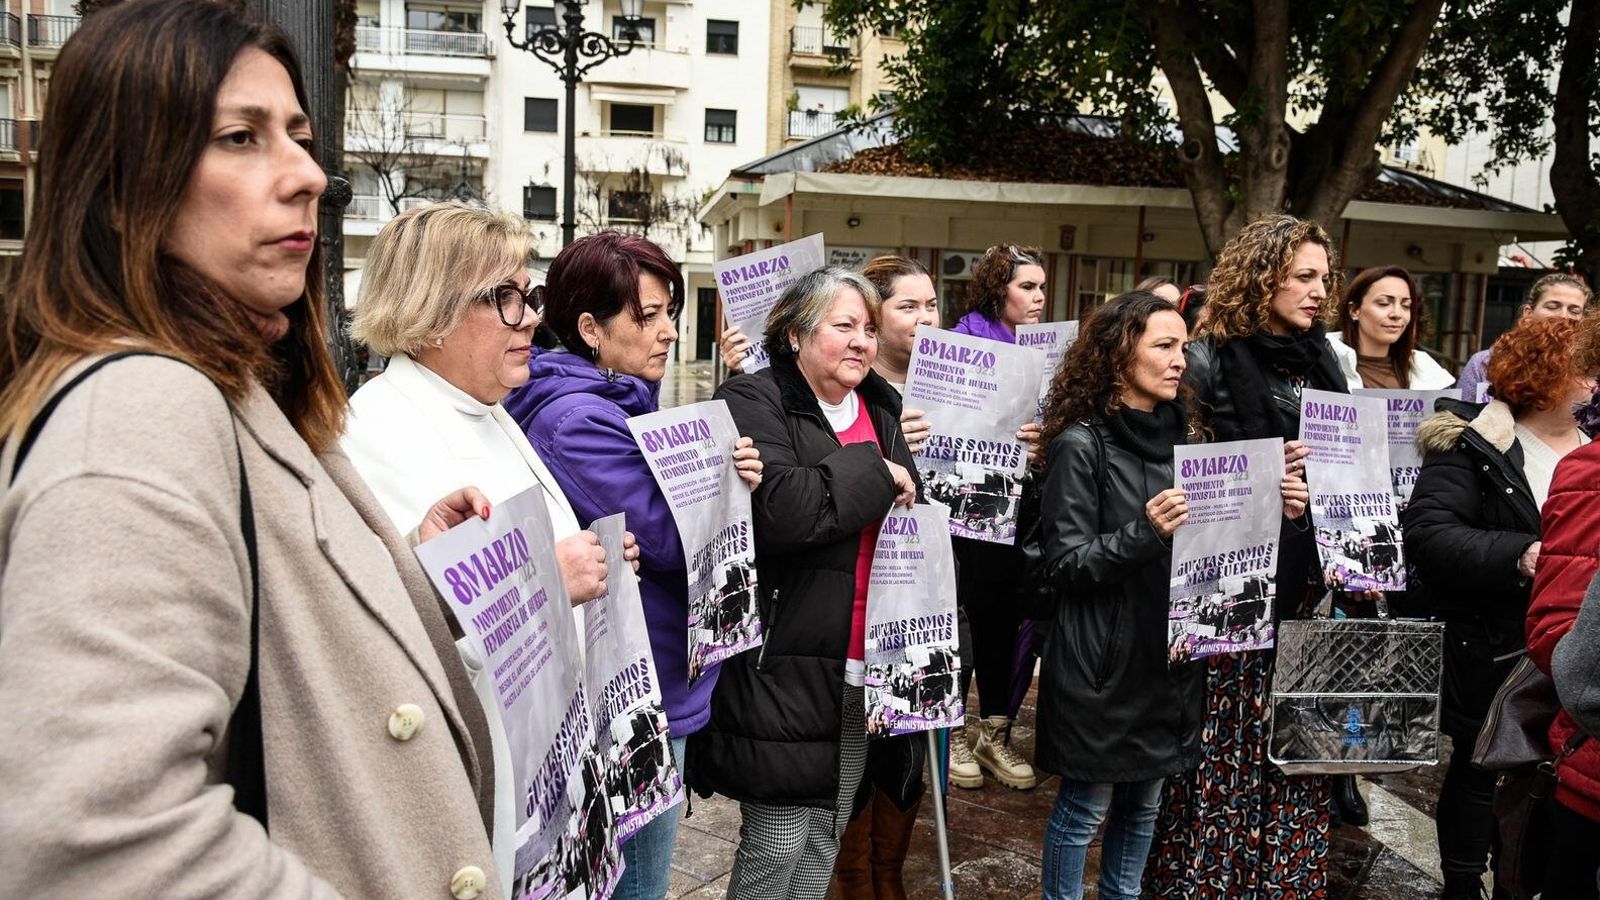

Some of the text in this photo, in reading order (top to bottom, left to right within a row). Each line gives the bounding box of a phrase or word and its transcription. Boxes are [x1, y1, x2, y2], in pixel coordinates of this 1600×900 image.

[720, 255, 789, 286] 8MARZO
[726, 279, 770, 297] MOVIMIENTO
[727, 290, 764, 305] FEMINISTA
[765, 286, 773, 295] DE
[1019, 332, 1057, 346] 8MARZO
[918, 337, 996, 368] 8MARZO
[917, 358, 965, 376] MOVIMIENTO
[914, 368, 998, 392] FEMINISTA DE HUELVA
[1305, 402, 1357, 423] 8MARZO
[641, 418, 711, 453] 8MARZO
[1304, 431, 1333, 442] FEMINISTA
[1305, 422, 1339, 433] MOVIMIENTO
[926, 434, 1022, 456] NTAS SOMOS
[654, 448, 698, 469] MOVIMIENTO
[954, 450, 1019, 468] FUERTES
[1181, 454, 1248, 478] 8MARZO
[660, 462, 697, 480] FEMINISTA
[697, 461, 705, 470] DE
[1182, 480, 1224, 492] MOVIMIENTO
[1185, 487, 1252, 501] MINISTA DE HUELVA
[1354, 492, 1390, 505] SOMOS
[1347, 504, 1392, 518] FUERTES
[882, 516, 918, 535] ARZO
[891, 551, 898, 559] DE
[900, 551, 924, 559] HUELVA
[1227, 542, 1273, 564] SOMOS
[444, 528, 528, 605] 8MARZO
[1217, 556, 1271, 578] FUERTES
[472, 586, 521, 635] MOVIMIENTO
[483, 612, 521, 657] FEMINISTA
[518, 604, 529, 624] DE
[527, 587, 548, 616] HUELVA
[910, 613, 952, 632] SOMOS
[901, 627, 952, 648] FUERTES
[609, 658, 648, 699] SOMOS
